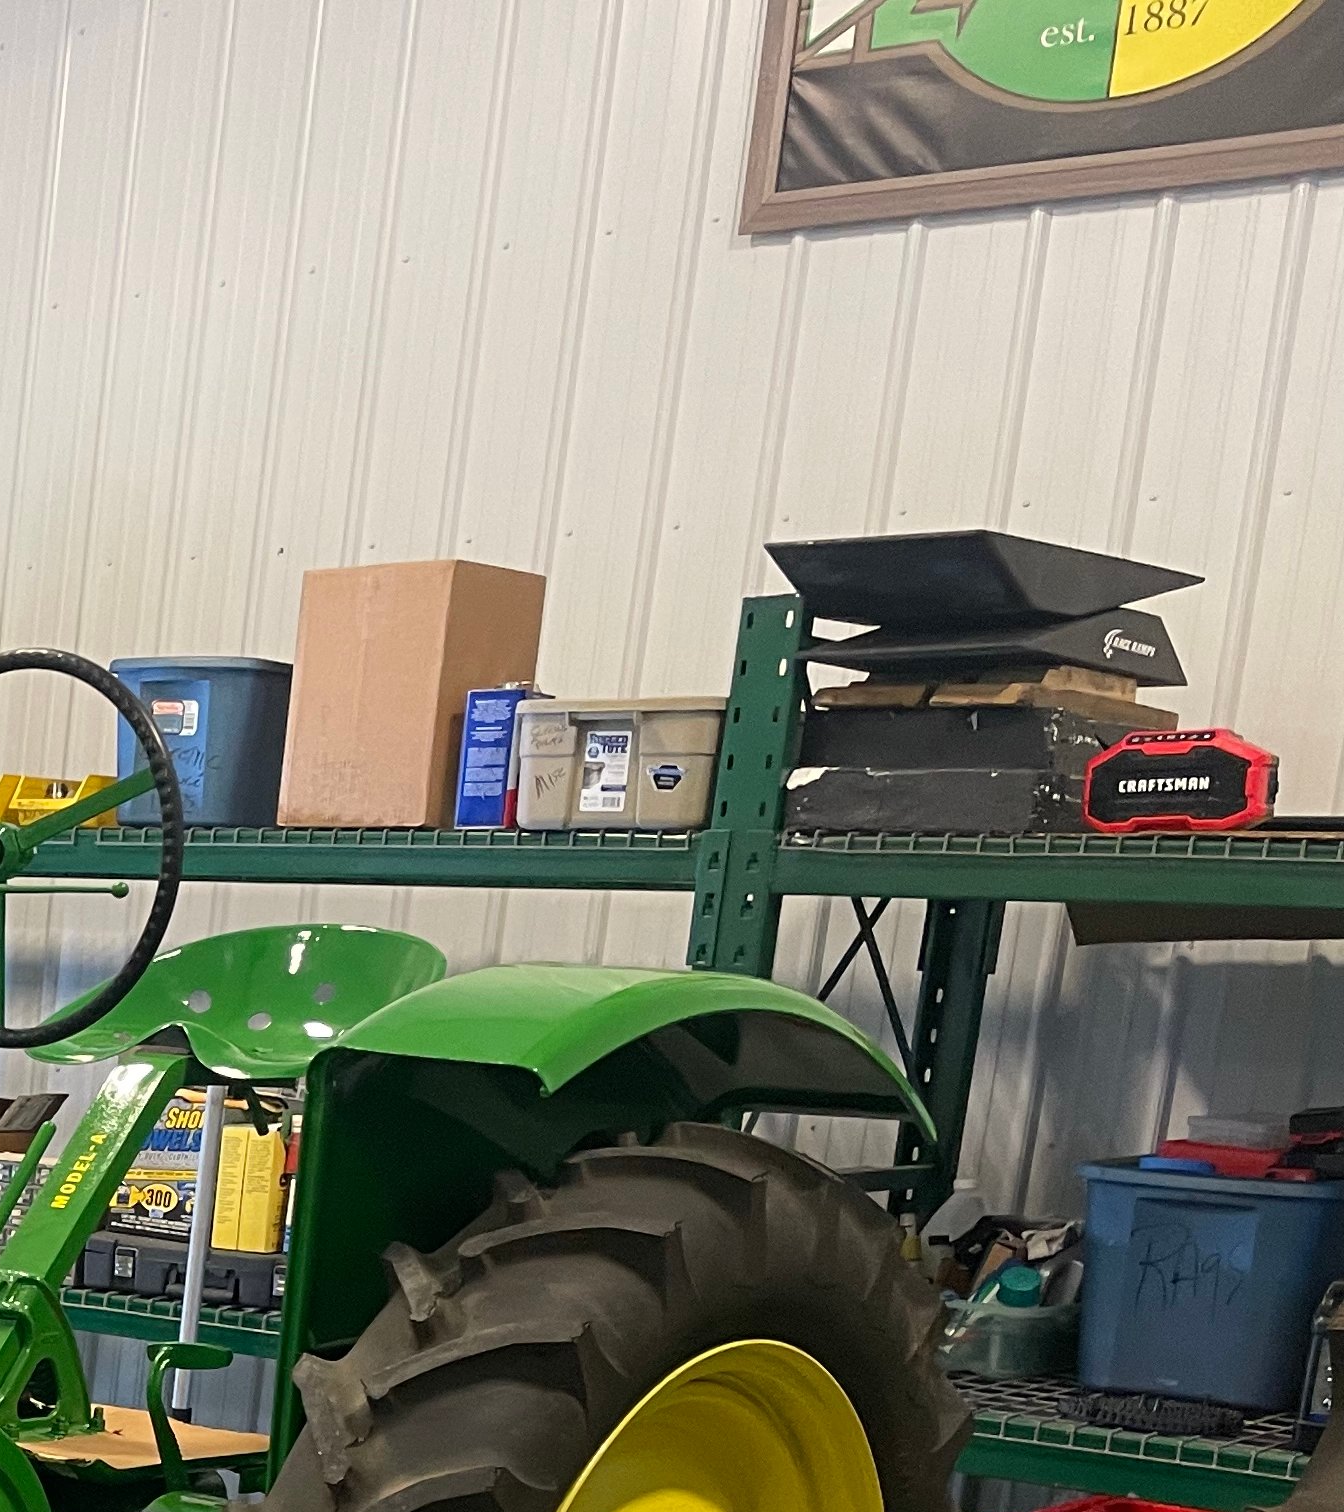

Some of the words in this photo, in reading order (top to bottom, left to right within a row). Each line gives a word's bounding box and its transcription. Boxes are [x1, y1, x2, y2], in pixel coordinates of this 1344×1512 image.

[1040, 17, 1095, 48] est.
[1123, 0, 1210, 36] 1887
[1118, 776, 1211, 793] CRAFTSMAN
[145, 1188, 172, 1209] 300
